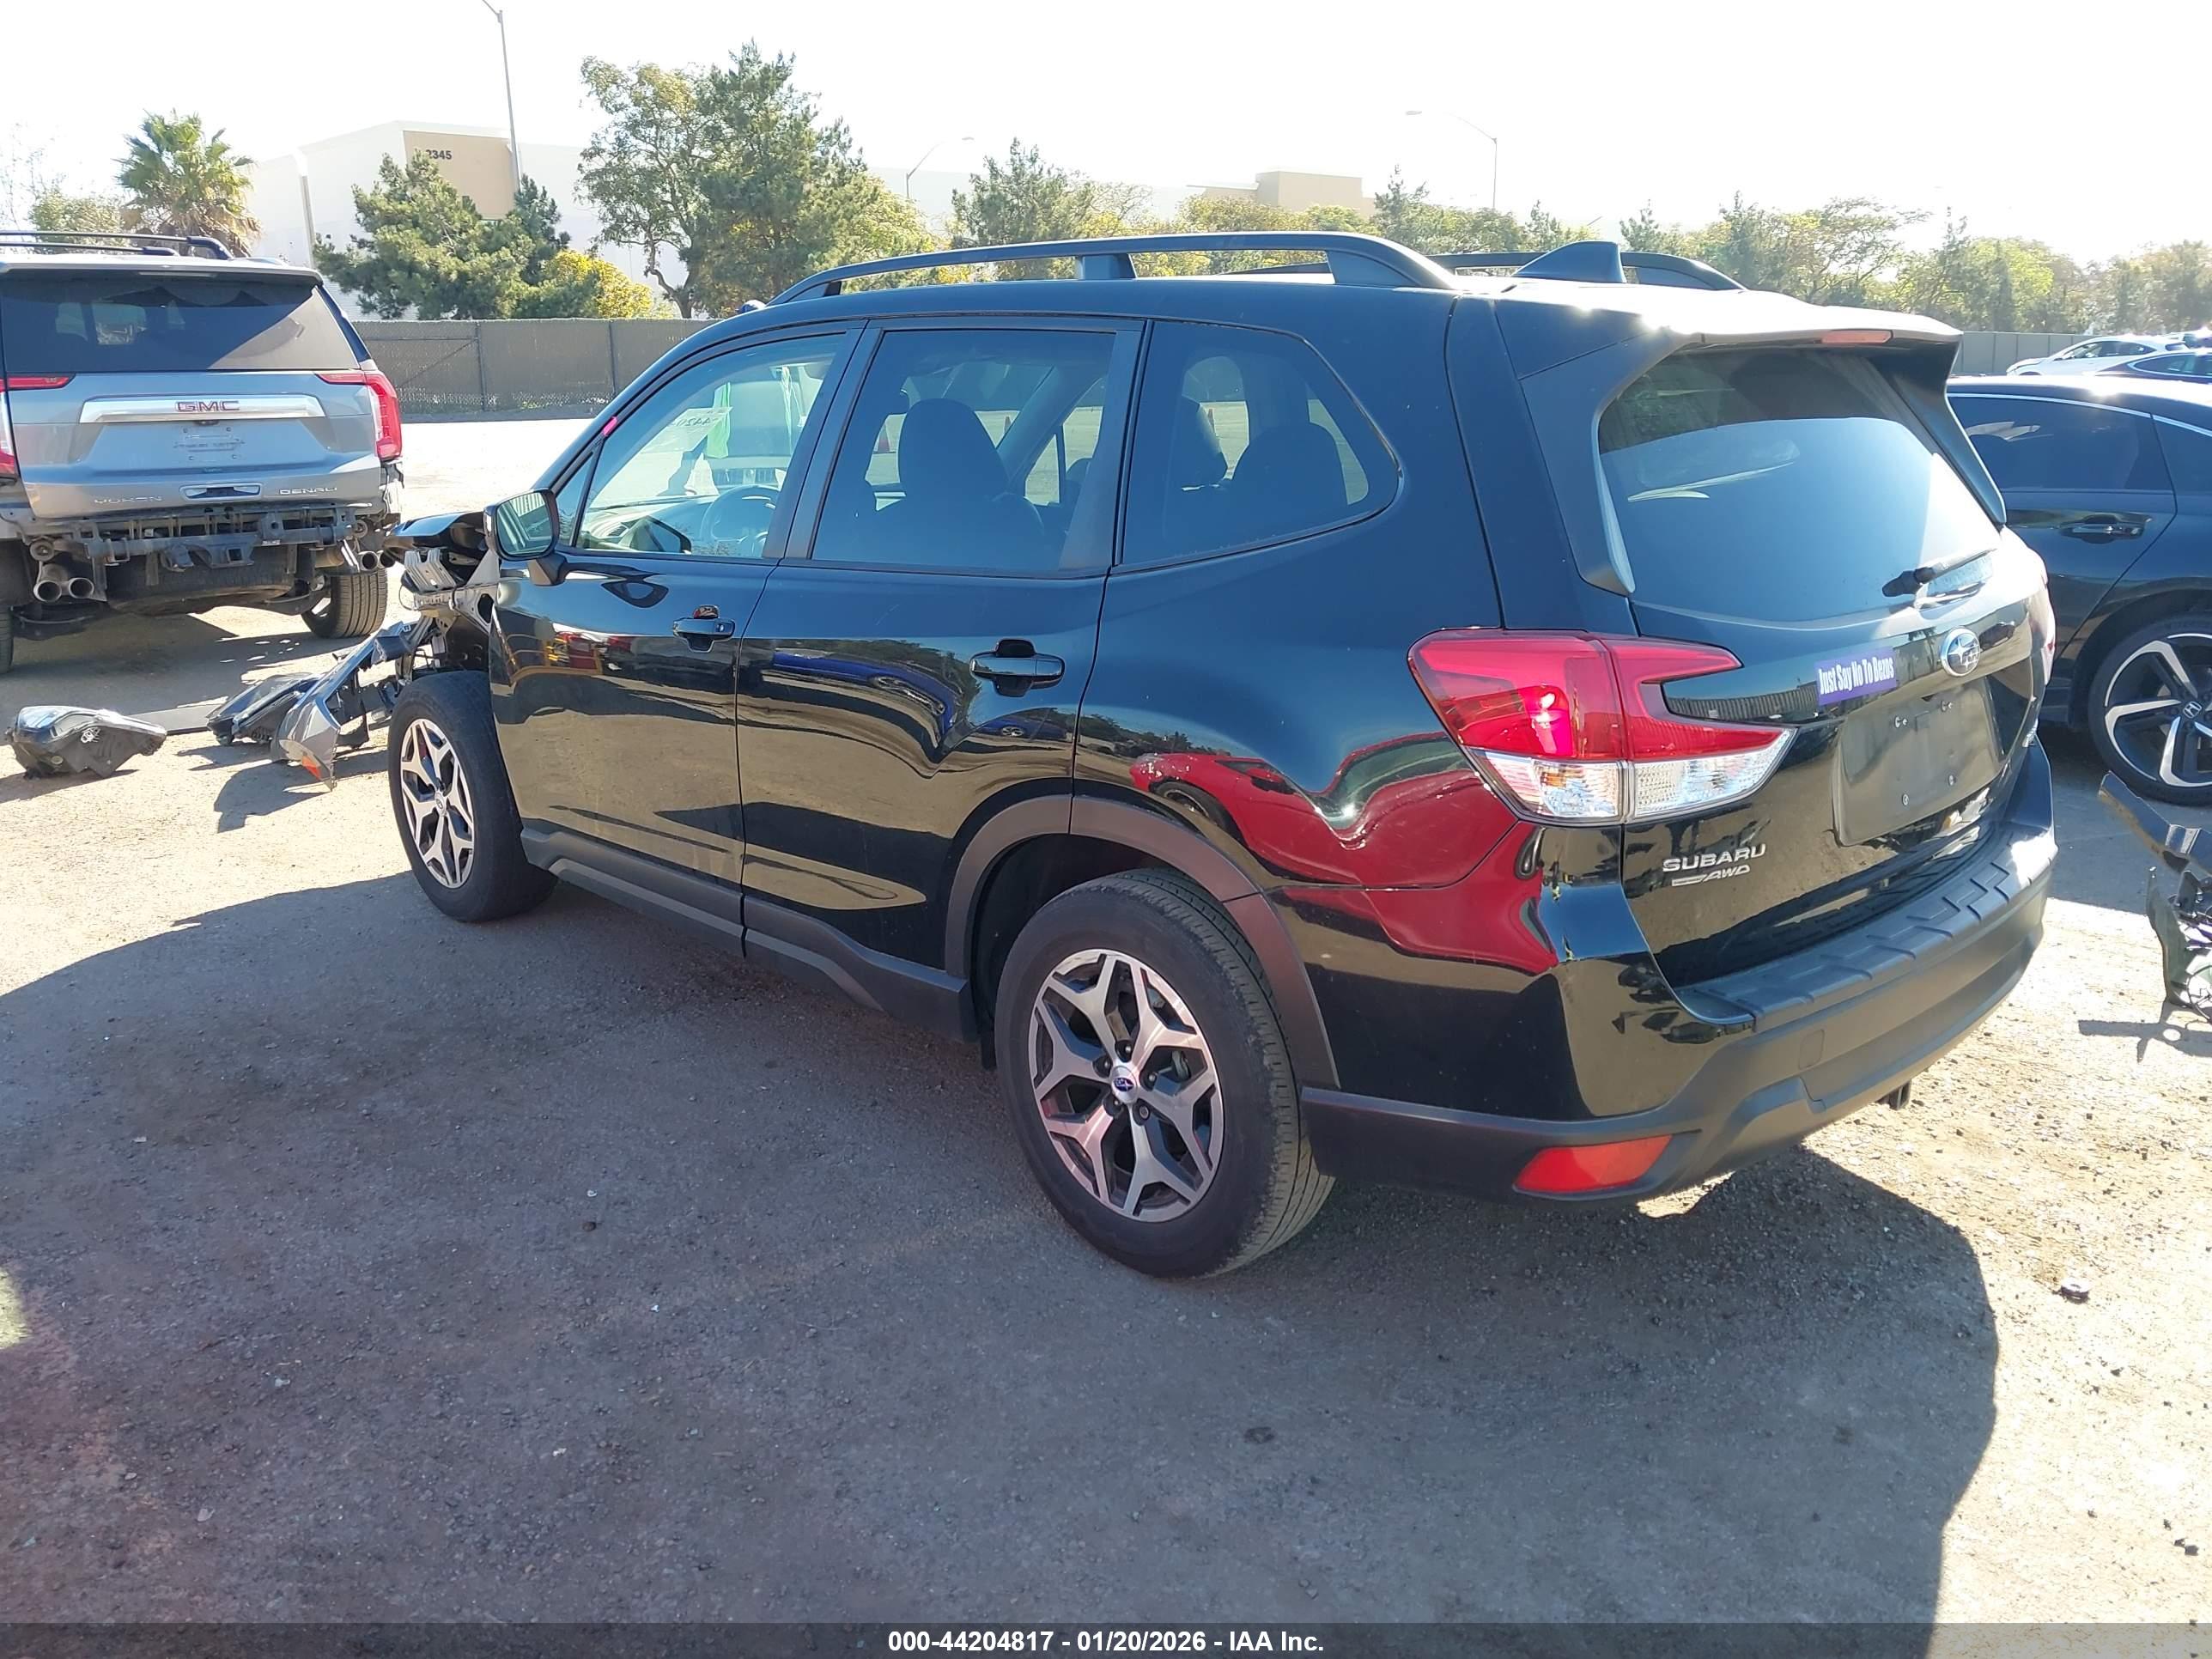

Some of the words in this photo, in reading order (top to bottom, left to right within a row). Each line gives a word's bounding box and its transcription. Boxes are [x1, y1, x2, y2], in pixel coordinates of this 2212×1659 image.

[176, 400, 240, 412] GMC
[1819, 668, 1838, 695] Just
[1836, 664, 1853, 691] Say
[1851, 660, 1864, 688] No
[1862, 659, 1874, 684] To
[1872, 656, 1894, 683] Bezos
[1662, 843, 1766, 872] SUBARU
[1702, 864, 1751, 883] AWD
